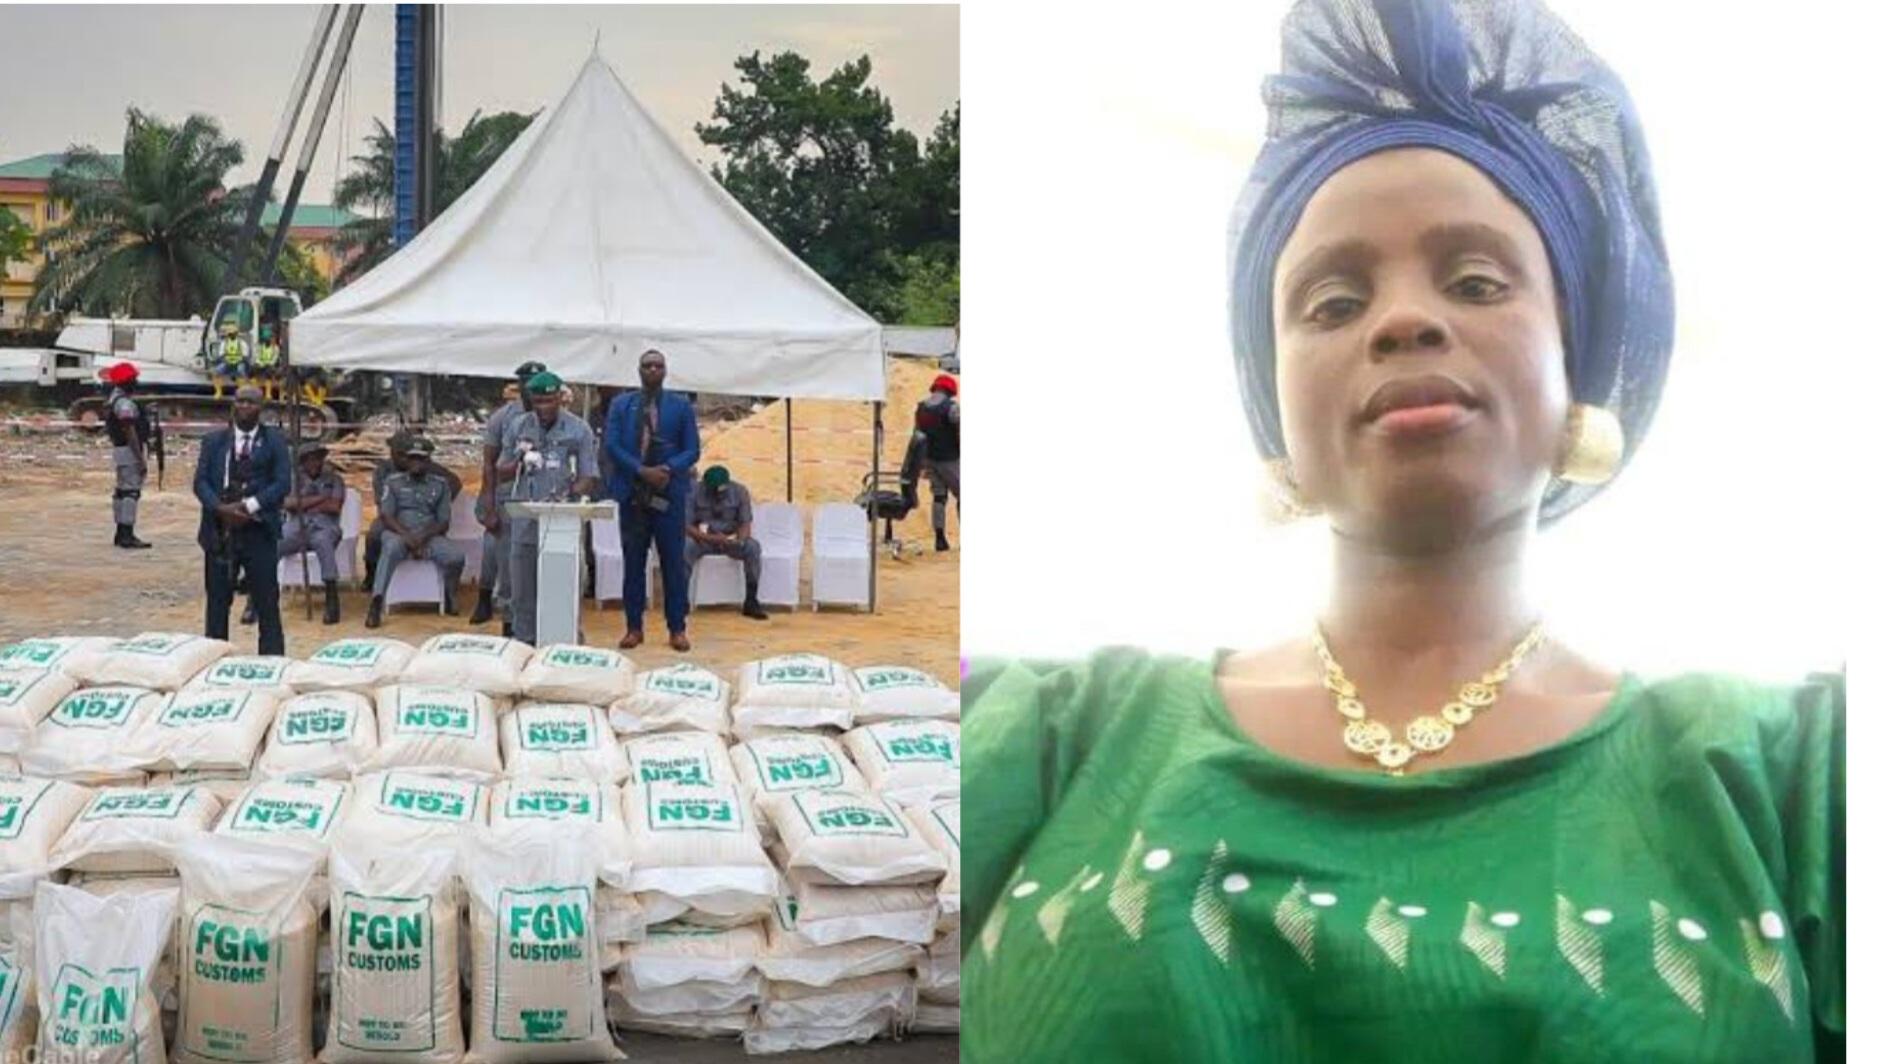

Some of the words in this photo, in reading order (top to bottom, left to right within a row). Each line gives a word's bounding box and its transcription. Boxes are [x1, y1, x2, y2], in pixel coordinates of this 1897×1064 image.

[318, 647, 375, 660] FGN
[552, 653, 608, 667] FGN
[216, 665, 275, 679] FGN
[63, 699, 125, 719] FGN
[169, 698, 233, 719] FGN
[405, 711, 468, 728] FGN
[529, 728, 587, 743] FGN
[890, 740, 953, 760] FGN
[769, 759, 832, 783] FGN
[96, 797, 172, 811] FGN
[390, 794, 465, 817] FGN
[517, 798, 591, 814] FGN
[658, 804, 732, 821] FGN
[245, 808, 319, 829] FGN
[819, 814, 894, 829] FGN
[349, 911, 422, 950] FGN
[510, 904, 584, 940] FGN
[195, 920, 269, 962] FGN
[349, 953, 421, 971] CUSTOMS
[510, 942, 582, 962] CUSTOMS
[195, 960, 265, 984] CUSTOMS
